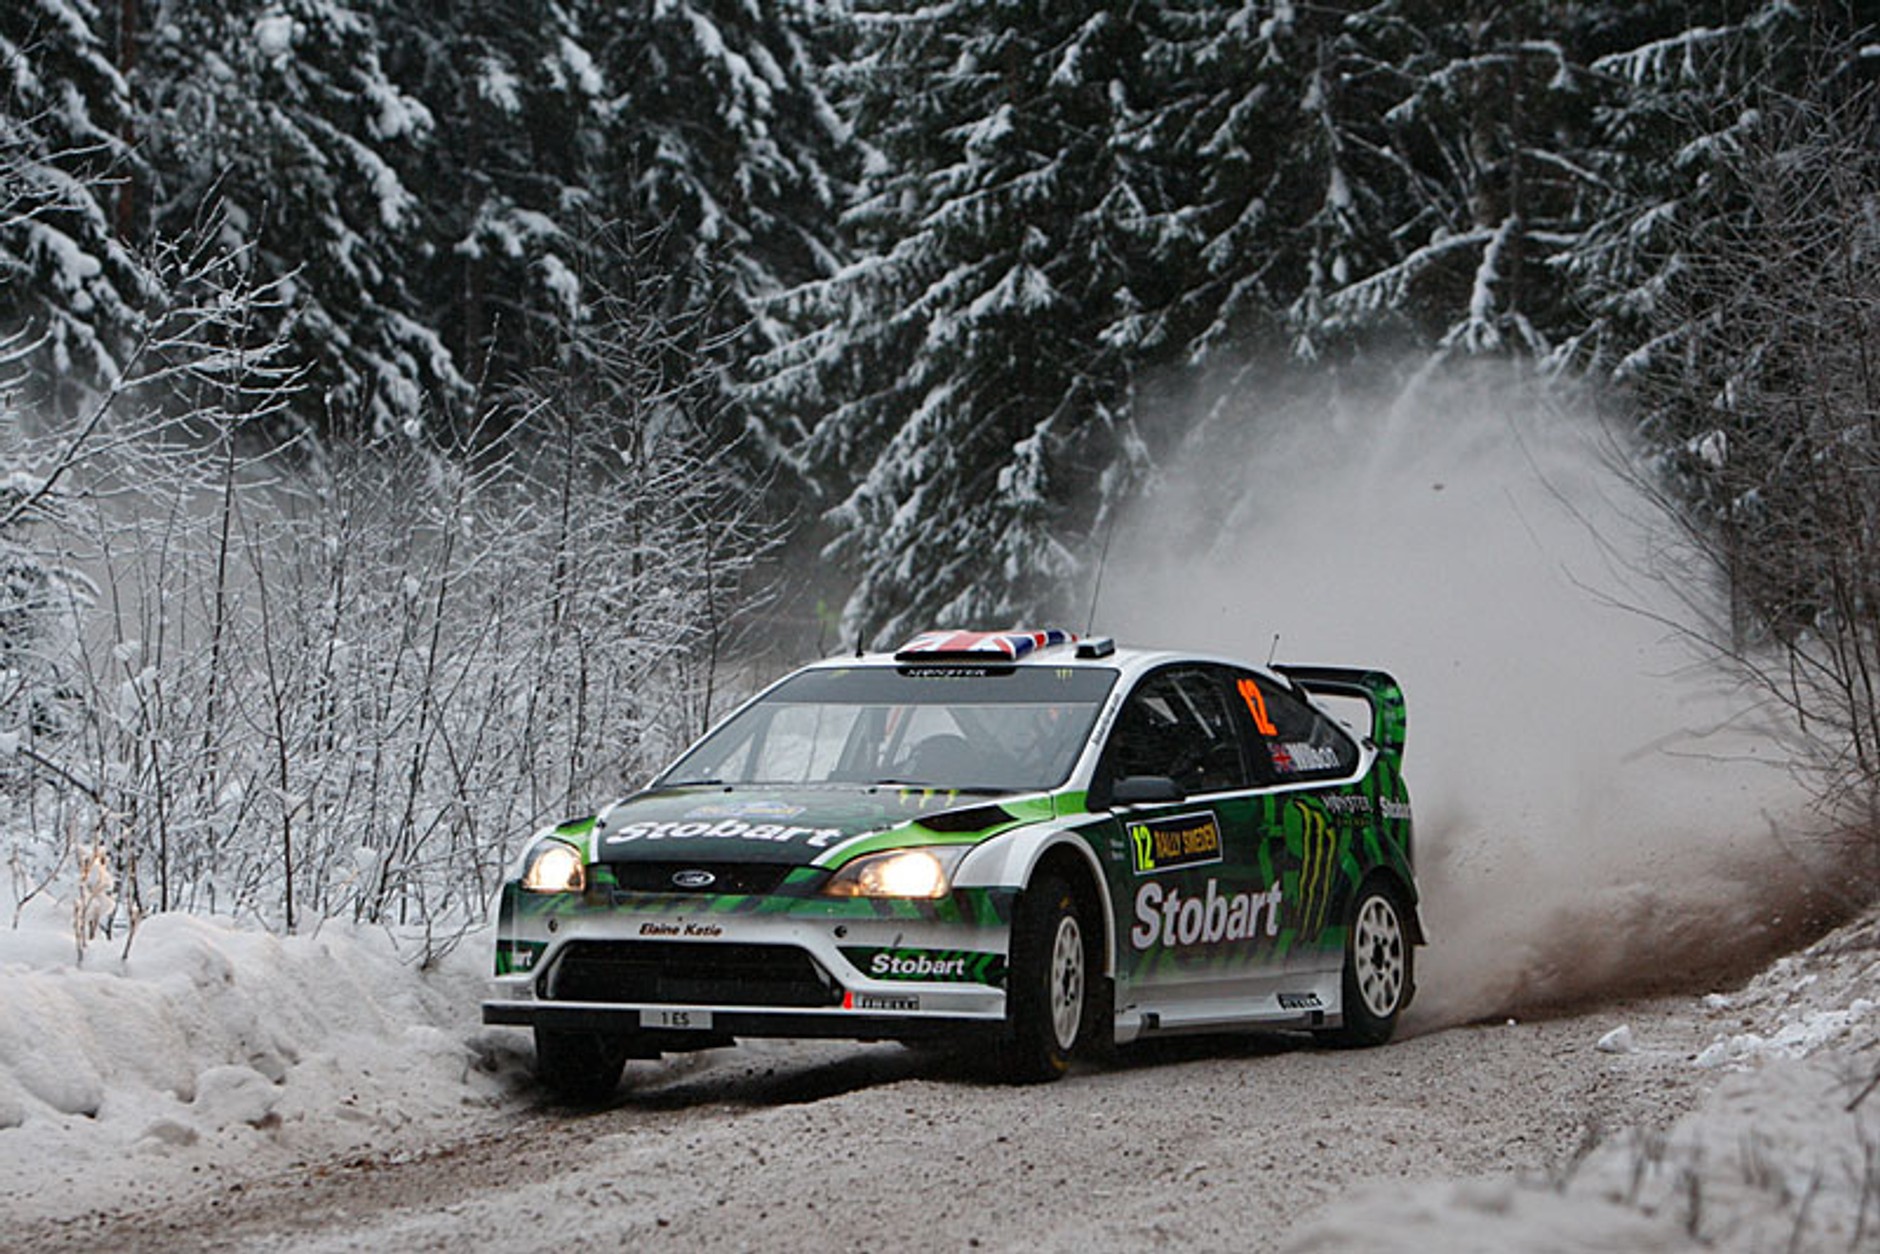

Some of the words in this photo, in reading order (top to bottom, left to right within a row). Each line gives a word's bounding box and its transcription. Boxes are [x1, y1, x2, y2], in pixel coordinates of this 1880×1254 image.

[1236, 679, 1279, 737] 12
[606, 819, 842, 848] Stobart
[1132, 825, 1155, 871] 12
[639, 922, 681, 936] Elaine
[684, 922, 724, 937] Katie
[1131, 877, 1283, 950] Stobart
[871, 953, 965, 976] Stobart
